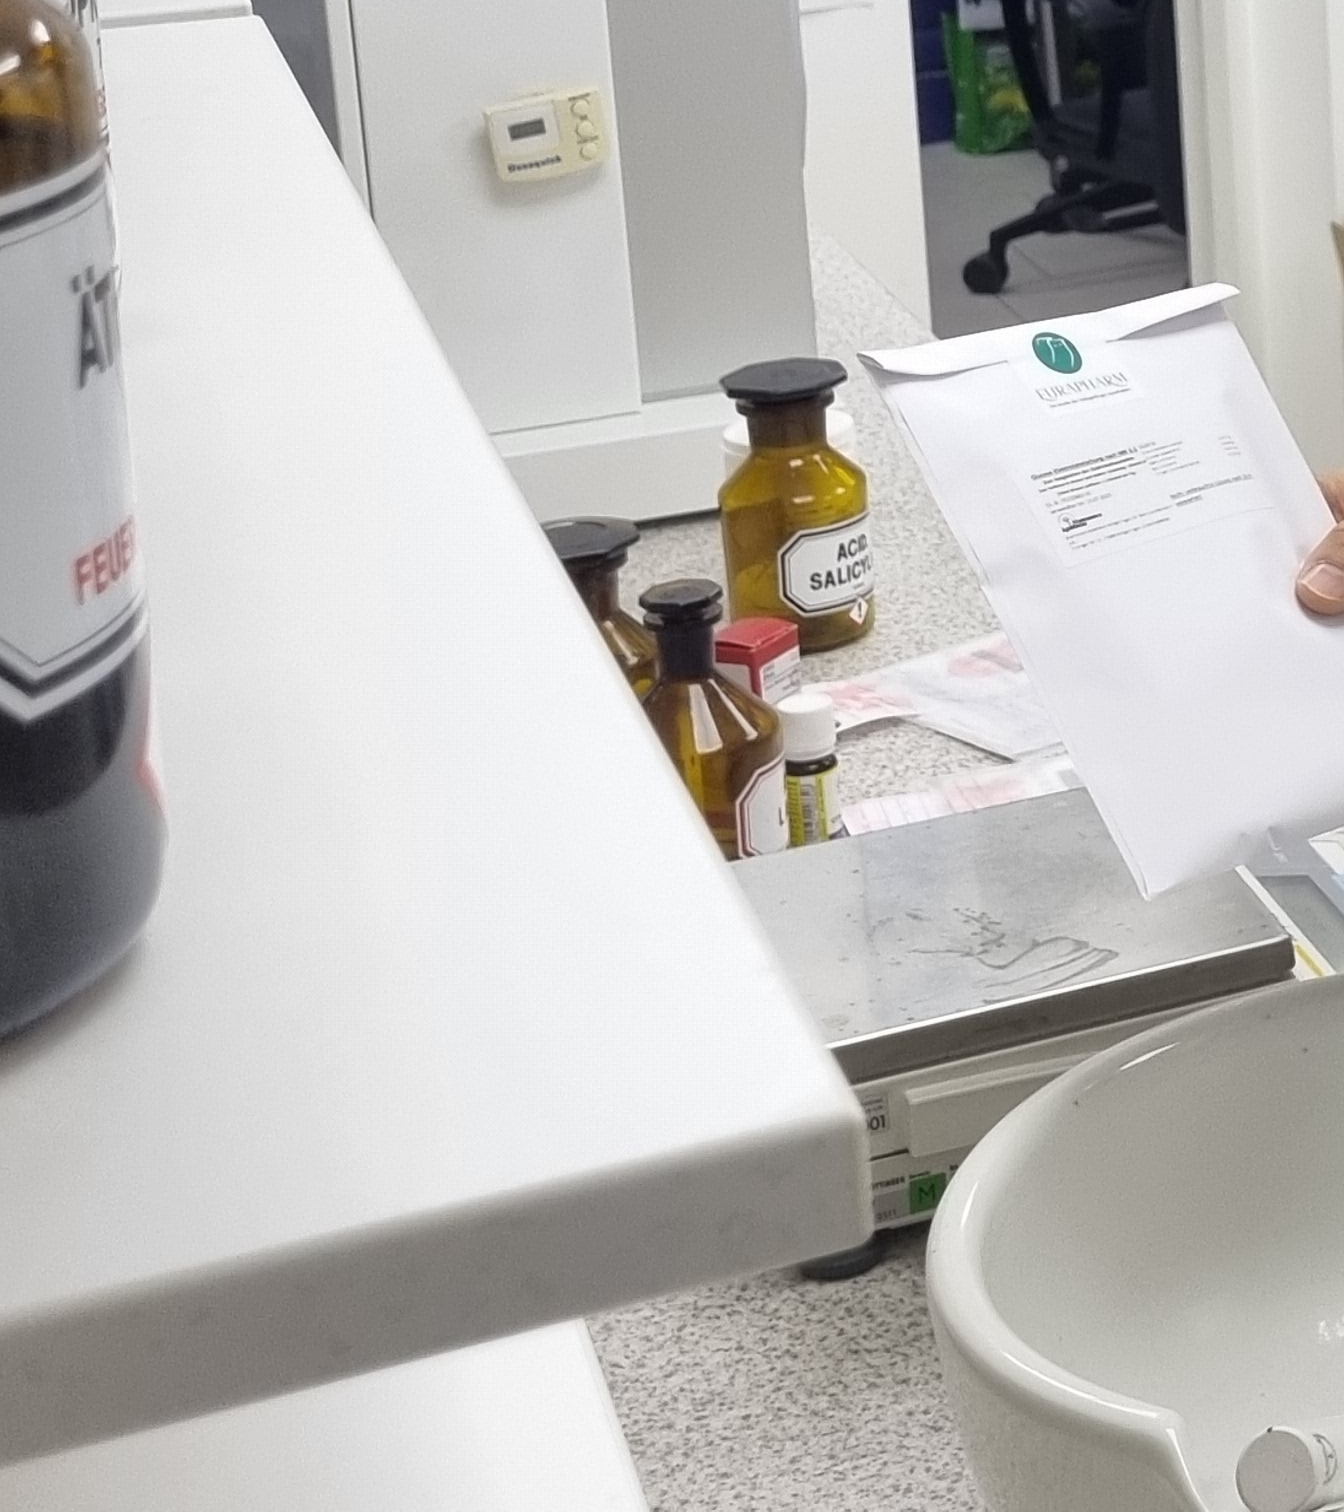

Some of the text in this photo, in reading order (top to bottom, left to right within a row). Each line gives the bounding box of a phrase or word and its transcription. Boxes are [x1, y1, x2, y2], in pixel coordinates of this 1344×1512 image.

[70, 265, 119, 390] ÄT
[74, 514, 135, 606] FEUE
[867, 1114, 887, 1132] 01
